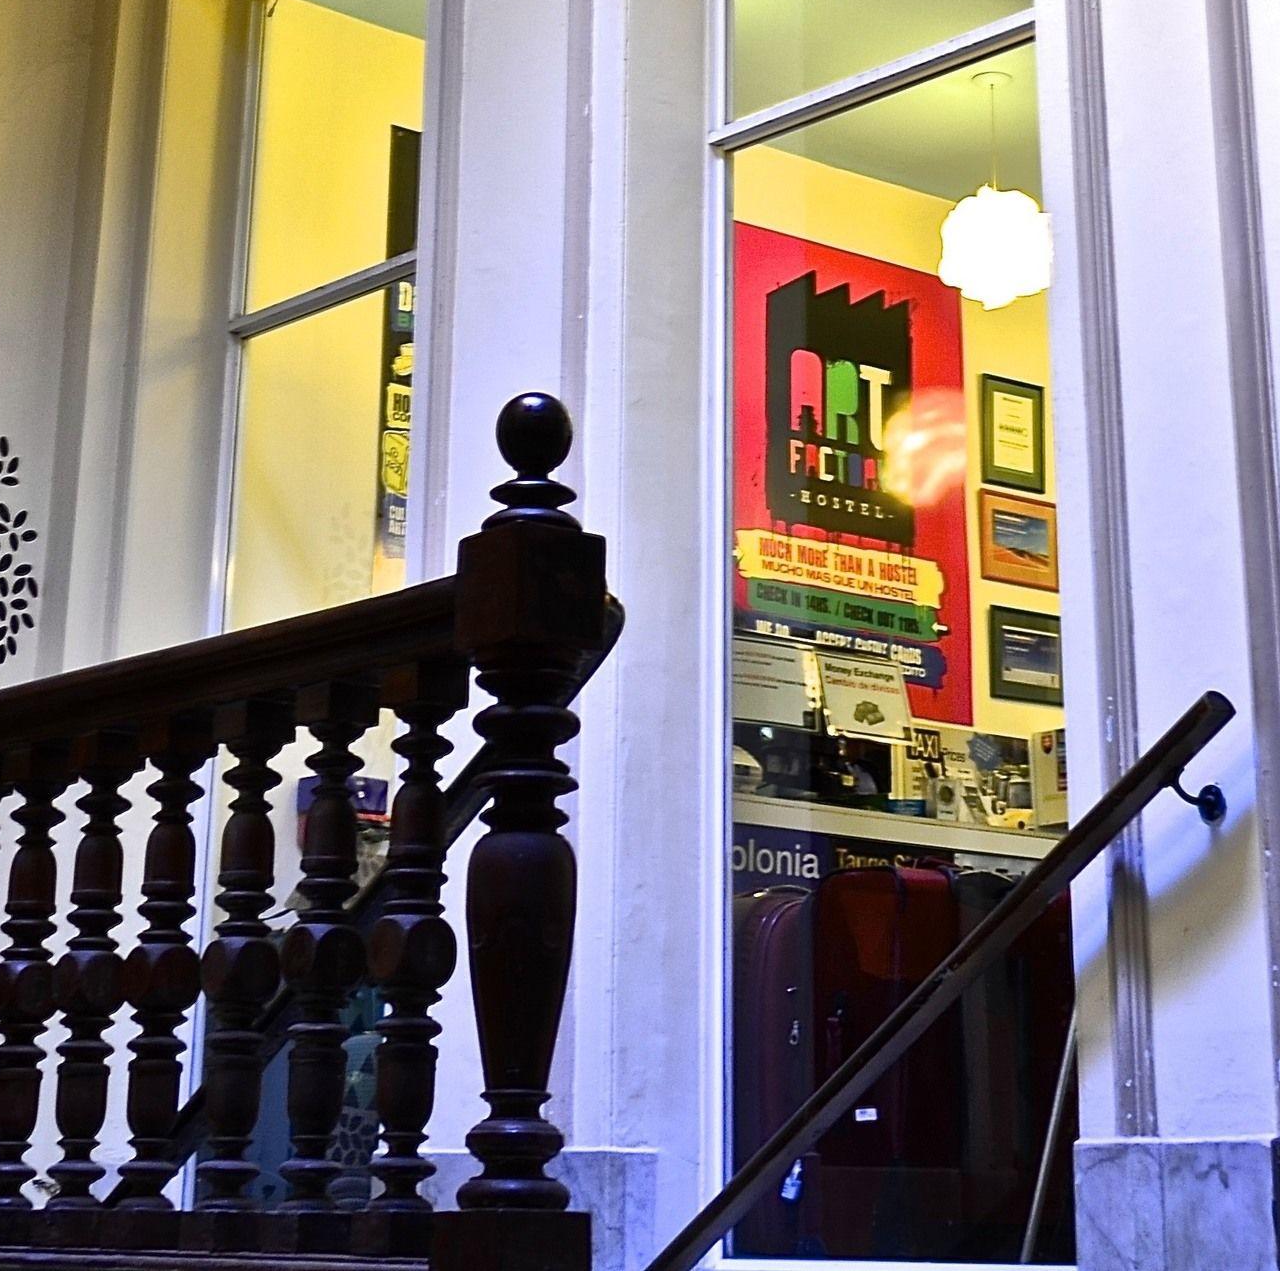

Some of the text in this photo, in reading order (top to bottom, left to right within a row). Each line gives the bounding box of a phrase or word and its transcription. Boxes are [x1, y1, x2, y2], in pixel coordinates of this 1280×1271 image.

[790, 349, 891, 451] ART
[790, 439, 887, 493] FACTOR
[759, 537, 918, 586] MUCH MORE THAN A HOSTEL
[762, 559, 803, 577] MUCHO
[806, 568, 831, 584] MAS
[833, 574, 856, 589] QUE
[874, 583, 917, 602] HOSTEL
[757, 583, 788, 605] CHECK
[844, 601, 874, 625] CHECK
[825, 662, 894, 683] Money Exchange
